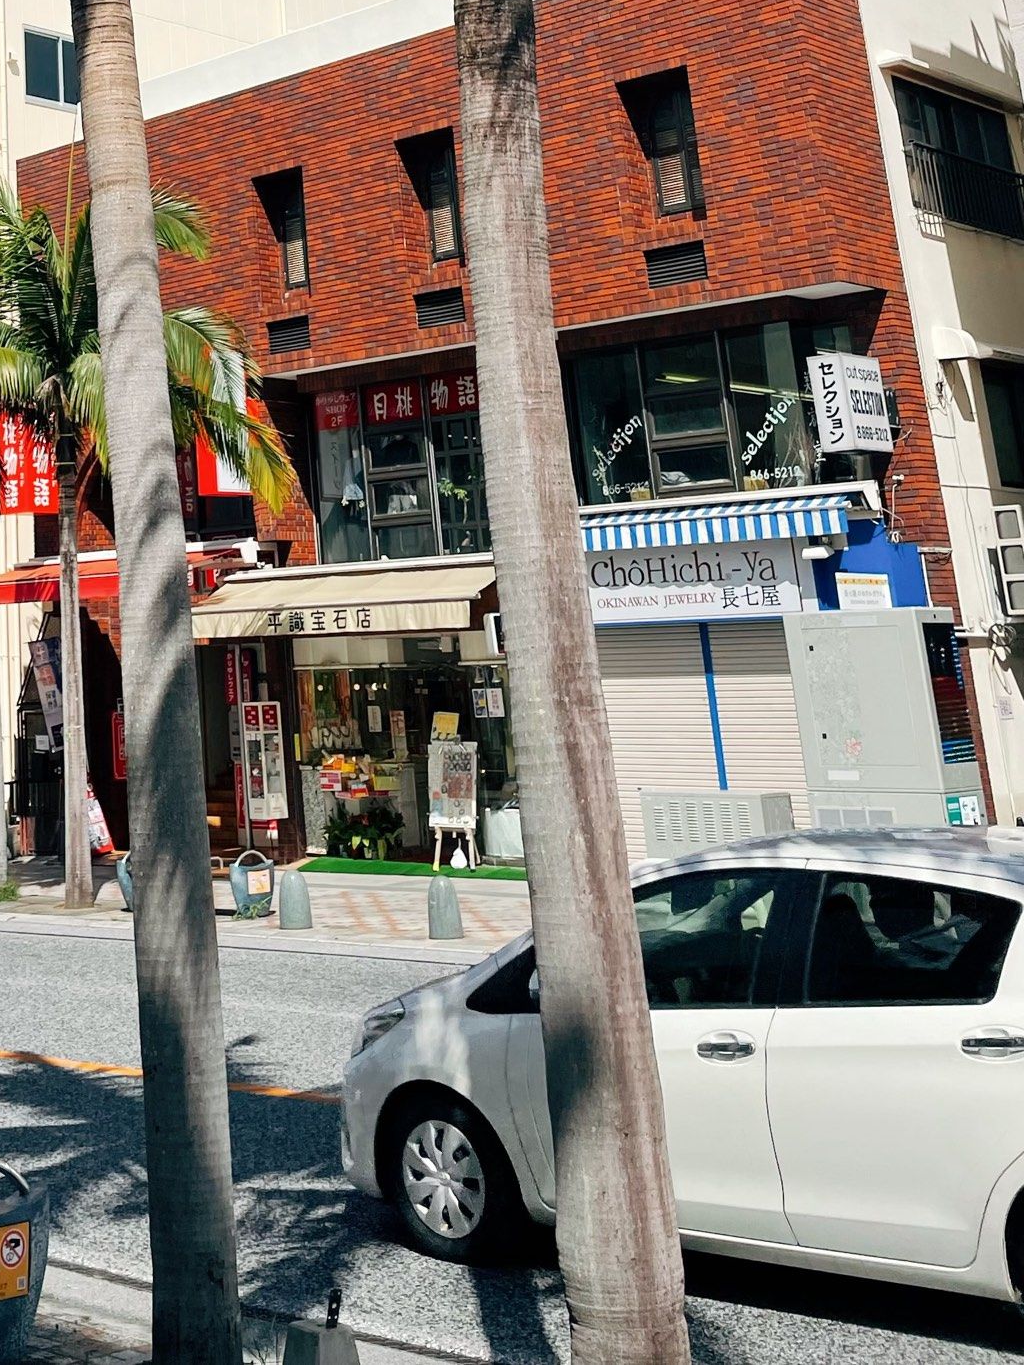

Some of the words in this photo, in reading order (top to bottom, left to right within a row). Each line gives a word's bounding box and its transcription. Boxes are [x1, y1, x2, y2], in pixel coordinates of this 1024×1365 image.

[858, 368, 879, 383] space
[326, 404, 348, 414] SHOP
[373, 375, 476, 421] 月桃物語
[818, 362, 844, 444] セレクション
[850, 389, 885, 416] SELECTION
[330, 416, 343, 427] 2F
[742, 392, 796, 465] selection
[749, 466, 801, 480] 866-5212
[597, 595, 659, 609] OKINAWAN
[663, 592, 717, 608] JEWELRY
[720, 584, 782, 609] 長七屋
[268, 607, 371, 633] 平識宝石店
